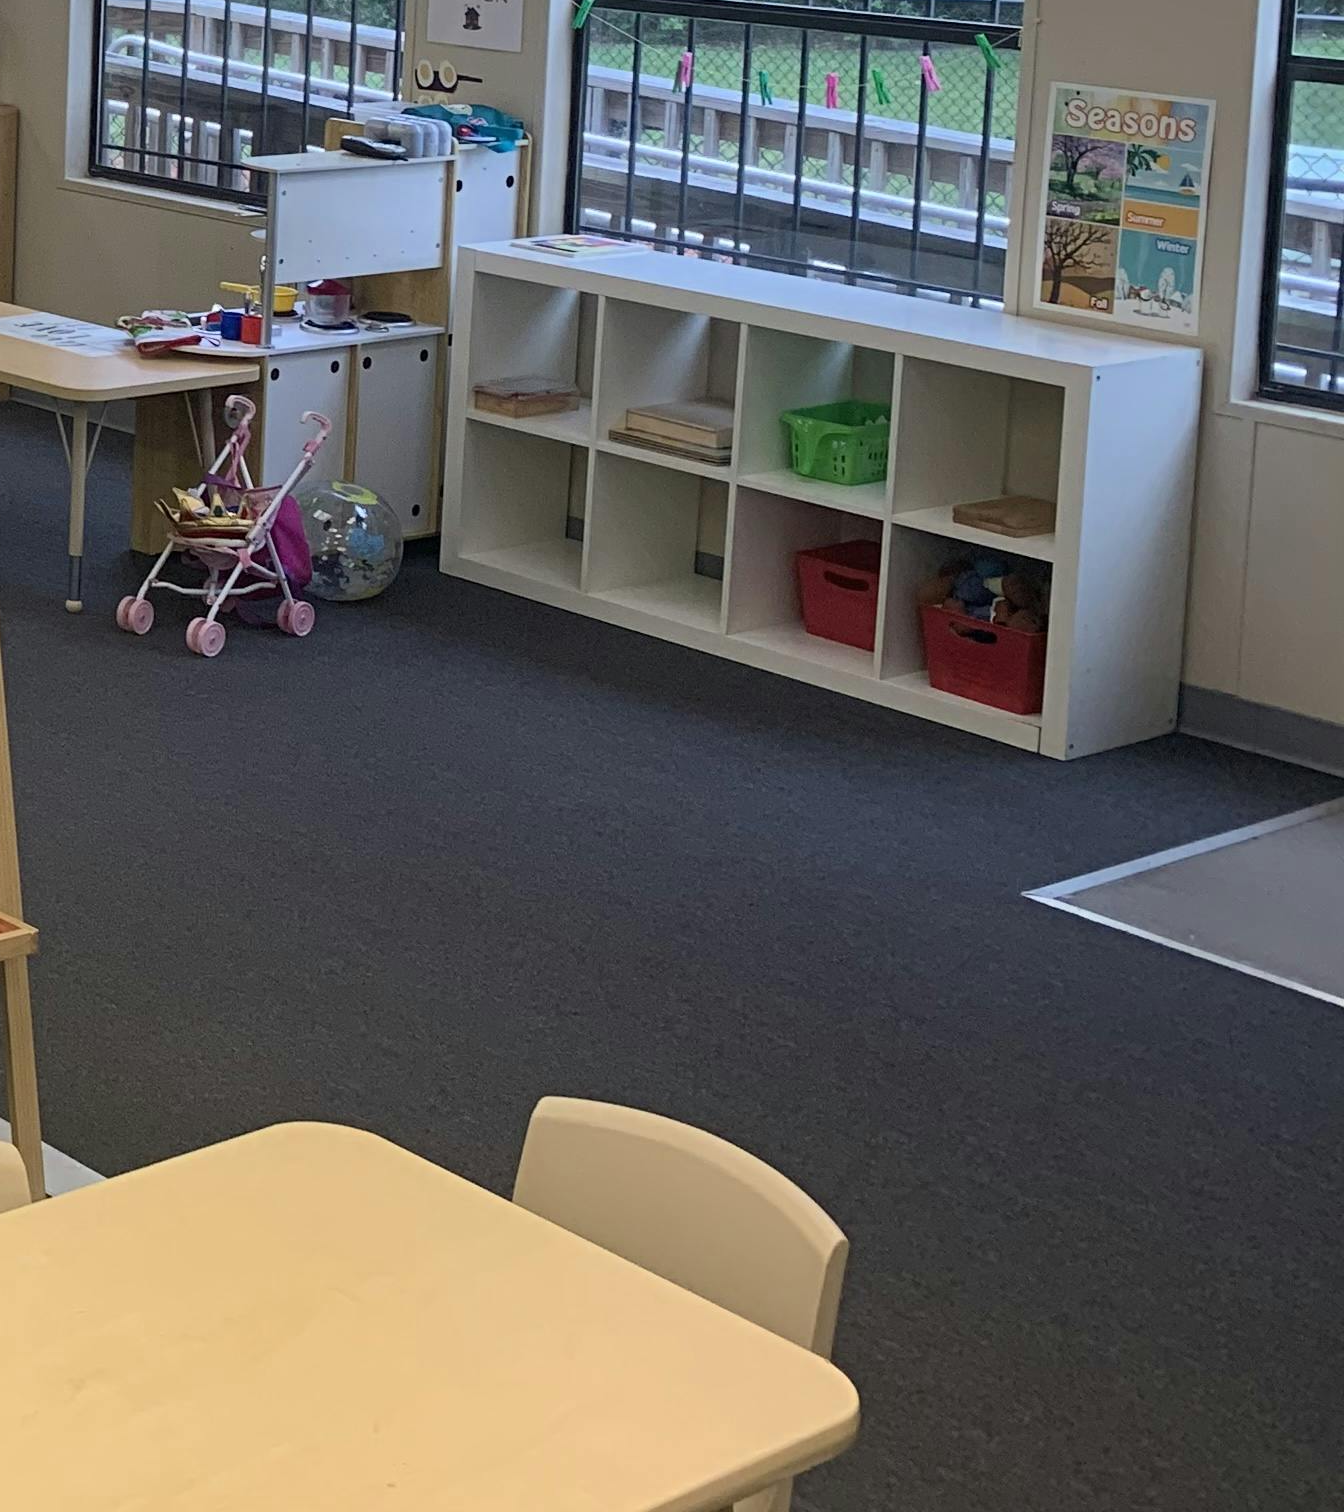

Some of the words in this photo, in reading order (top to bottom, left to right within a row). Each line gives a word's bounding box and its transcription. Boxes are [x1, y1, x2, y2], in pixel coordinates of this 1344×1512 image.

[1065, 97, 1197, 143] Seasons
[1051, 200, 1081, 217] Spring
[1126, 211, 1165, 227] Summer
[1155, 238, 1191, 255] Winter
[1089, 295, 1109, 311] Fall
